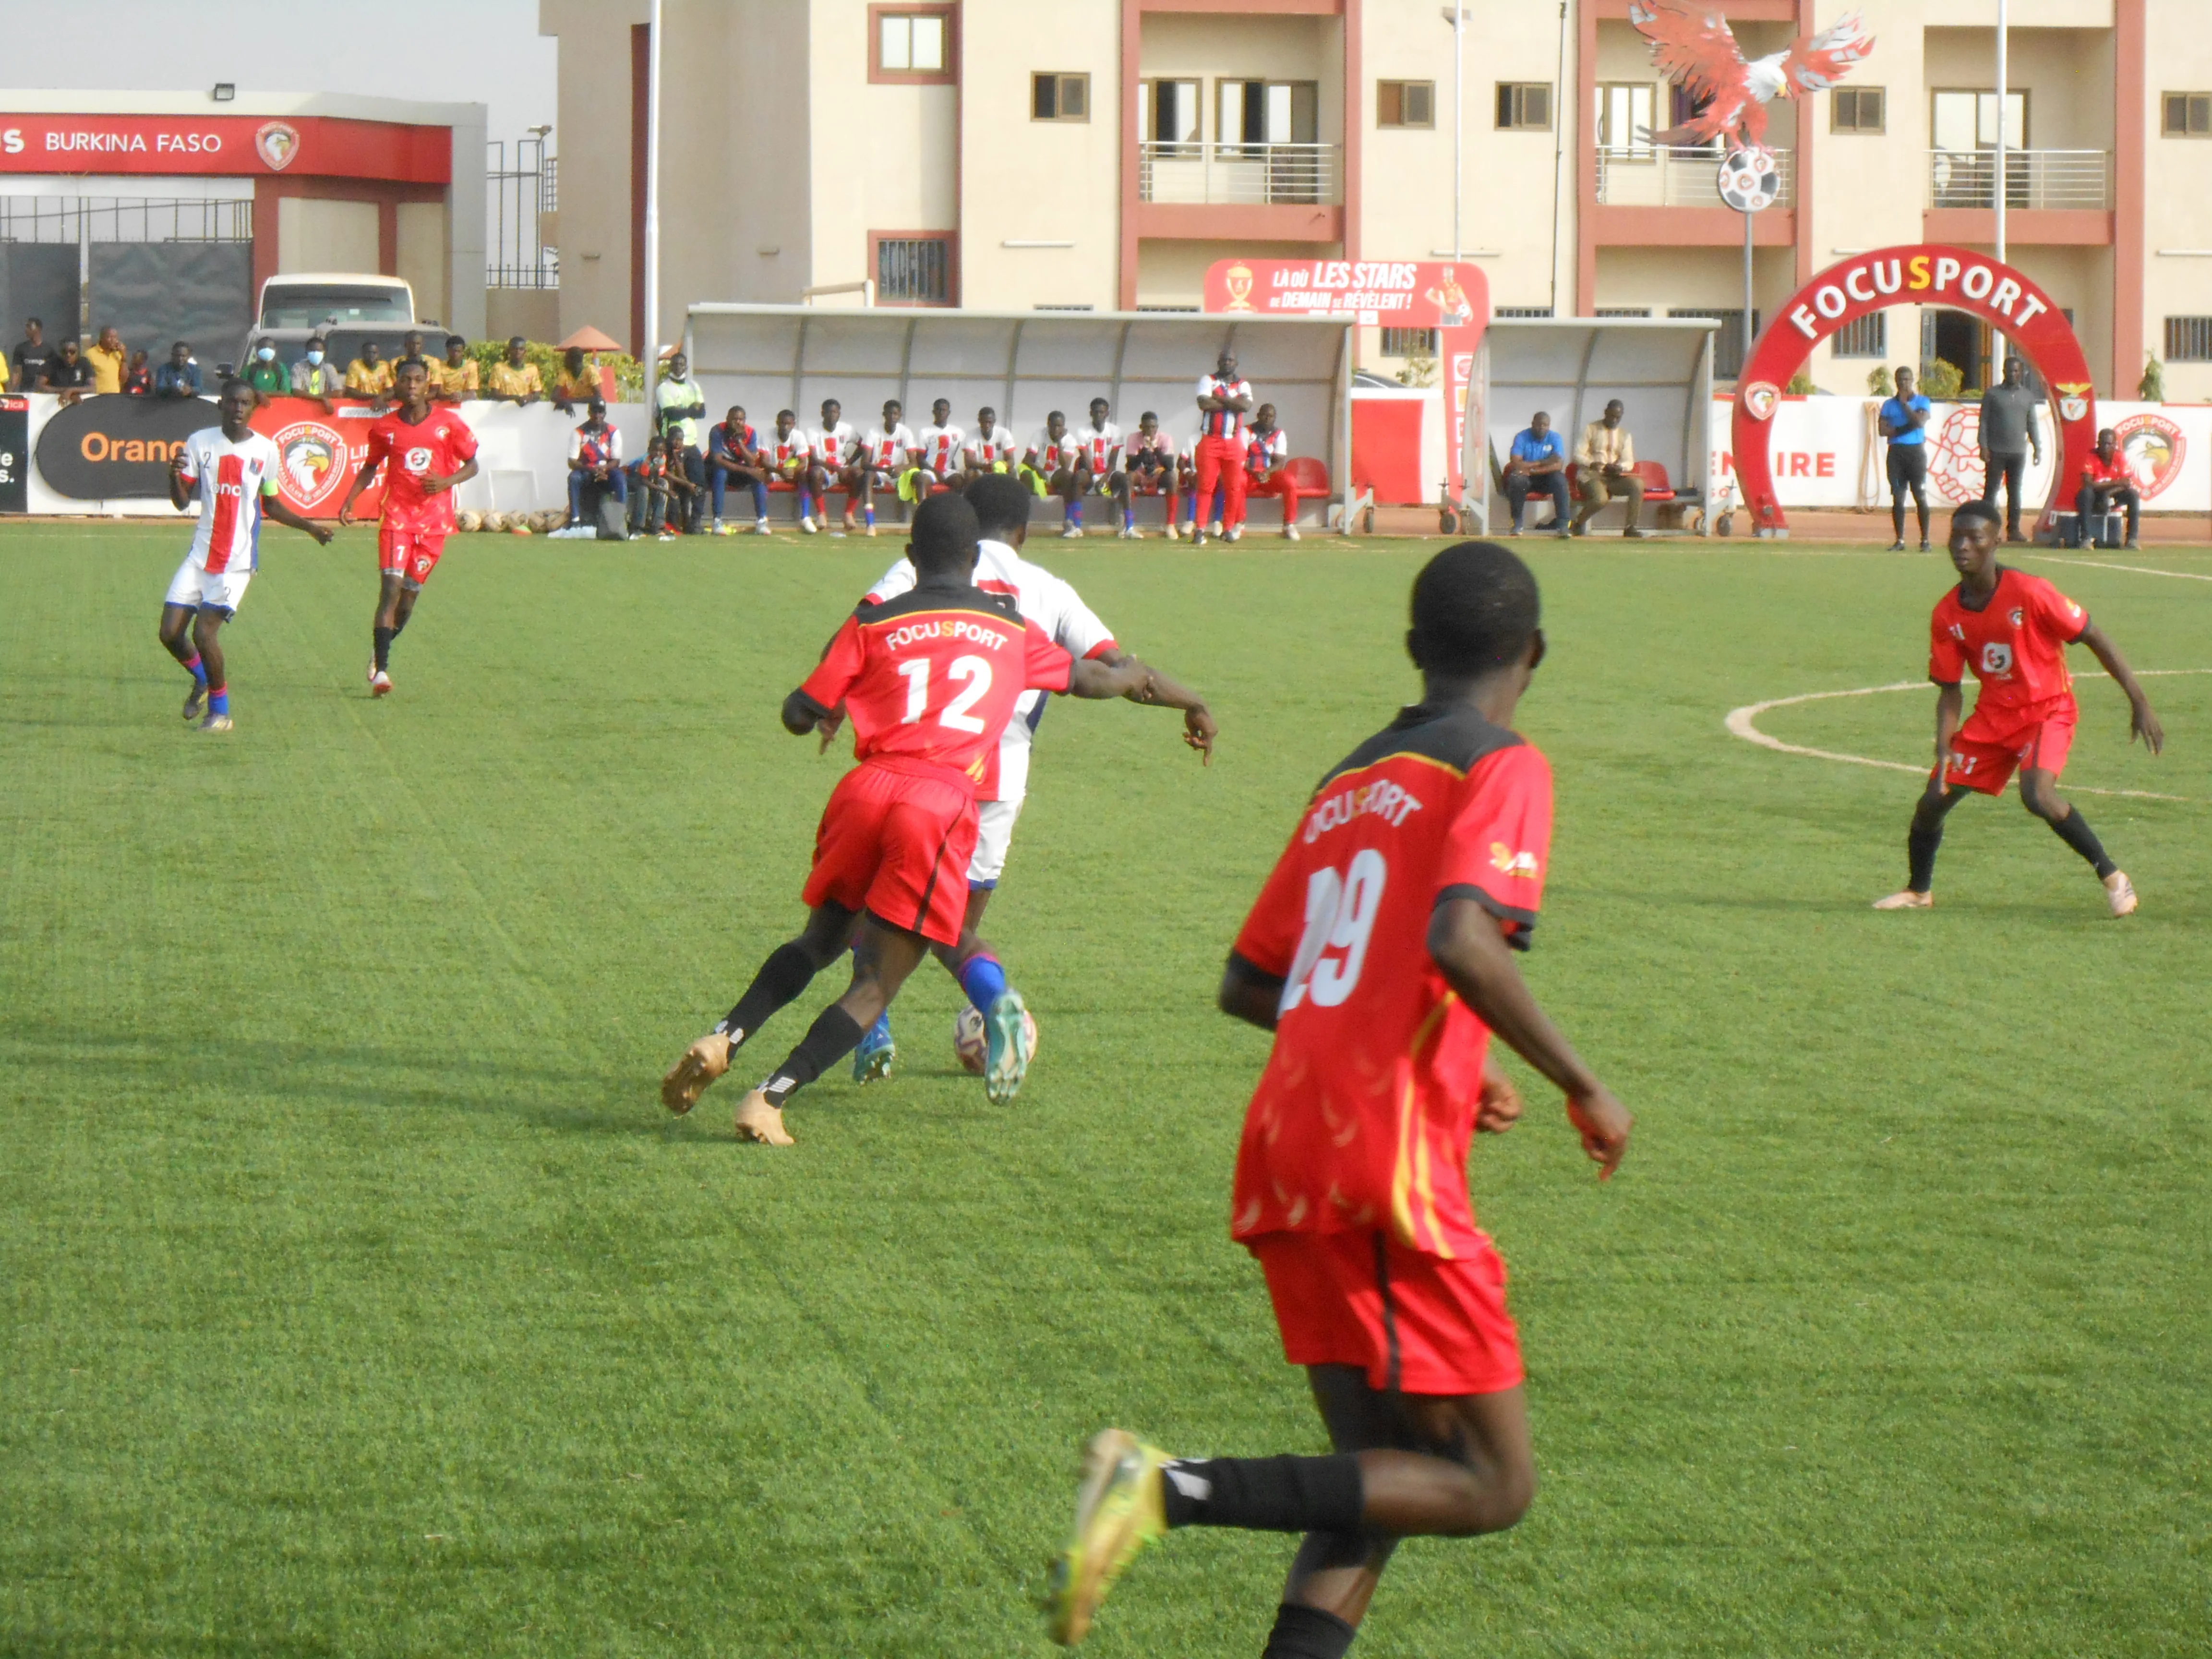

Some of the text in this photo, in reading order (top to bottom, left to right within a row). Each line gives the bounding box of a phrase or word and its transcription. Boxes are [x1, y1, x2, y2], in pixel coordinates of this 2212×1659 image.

[46, 132, 146, 152] BURKINA
[156, 134, 222, 153] FASO
[1313, 262, 1351, 288] LES
[1351, 262, 1417, 289] STARS
[1281, 291, 1332, 308] DEMAIN
[1343, 289, 1407, 309] RÉVÈLENT
[1790, 255, 2047, 340] FOCUSPORT
[81, 432, 188, 462] Oran
[278, 425, 337, 444] FOCUSPORT
[204, 452, 211, 469] 2
[885, 620, 1008, 651] FOCUSPORT
[898, 655, 993, 735] 12
[1276, 848, 1387, 1021] 19
